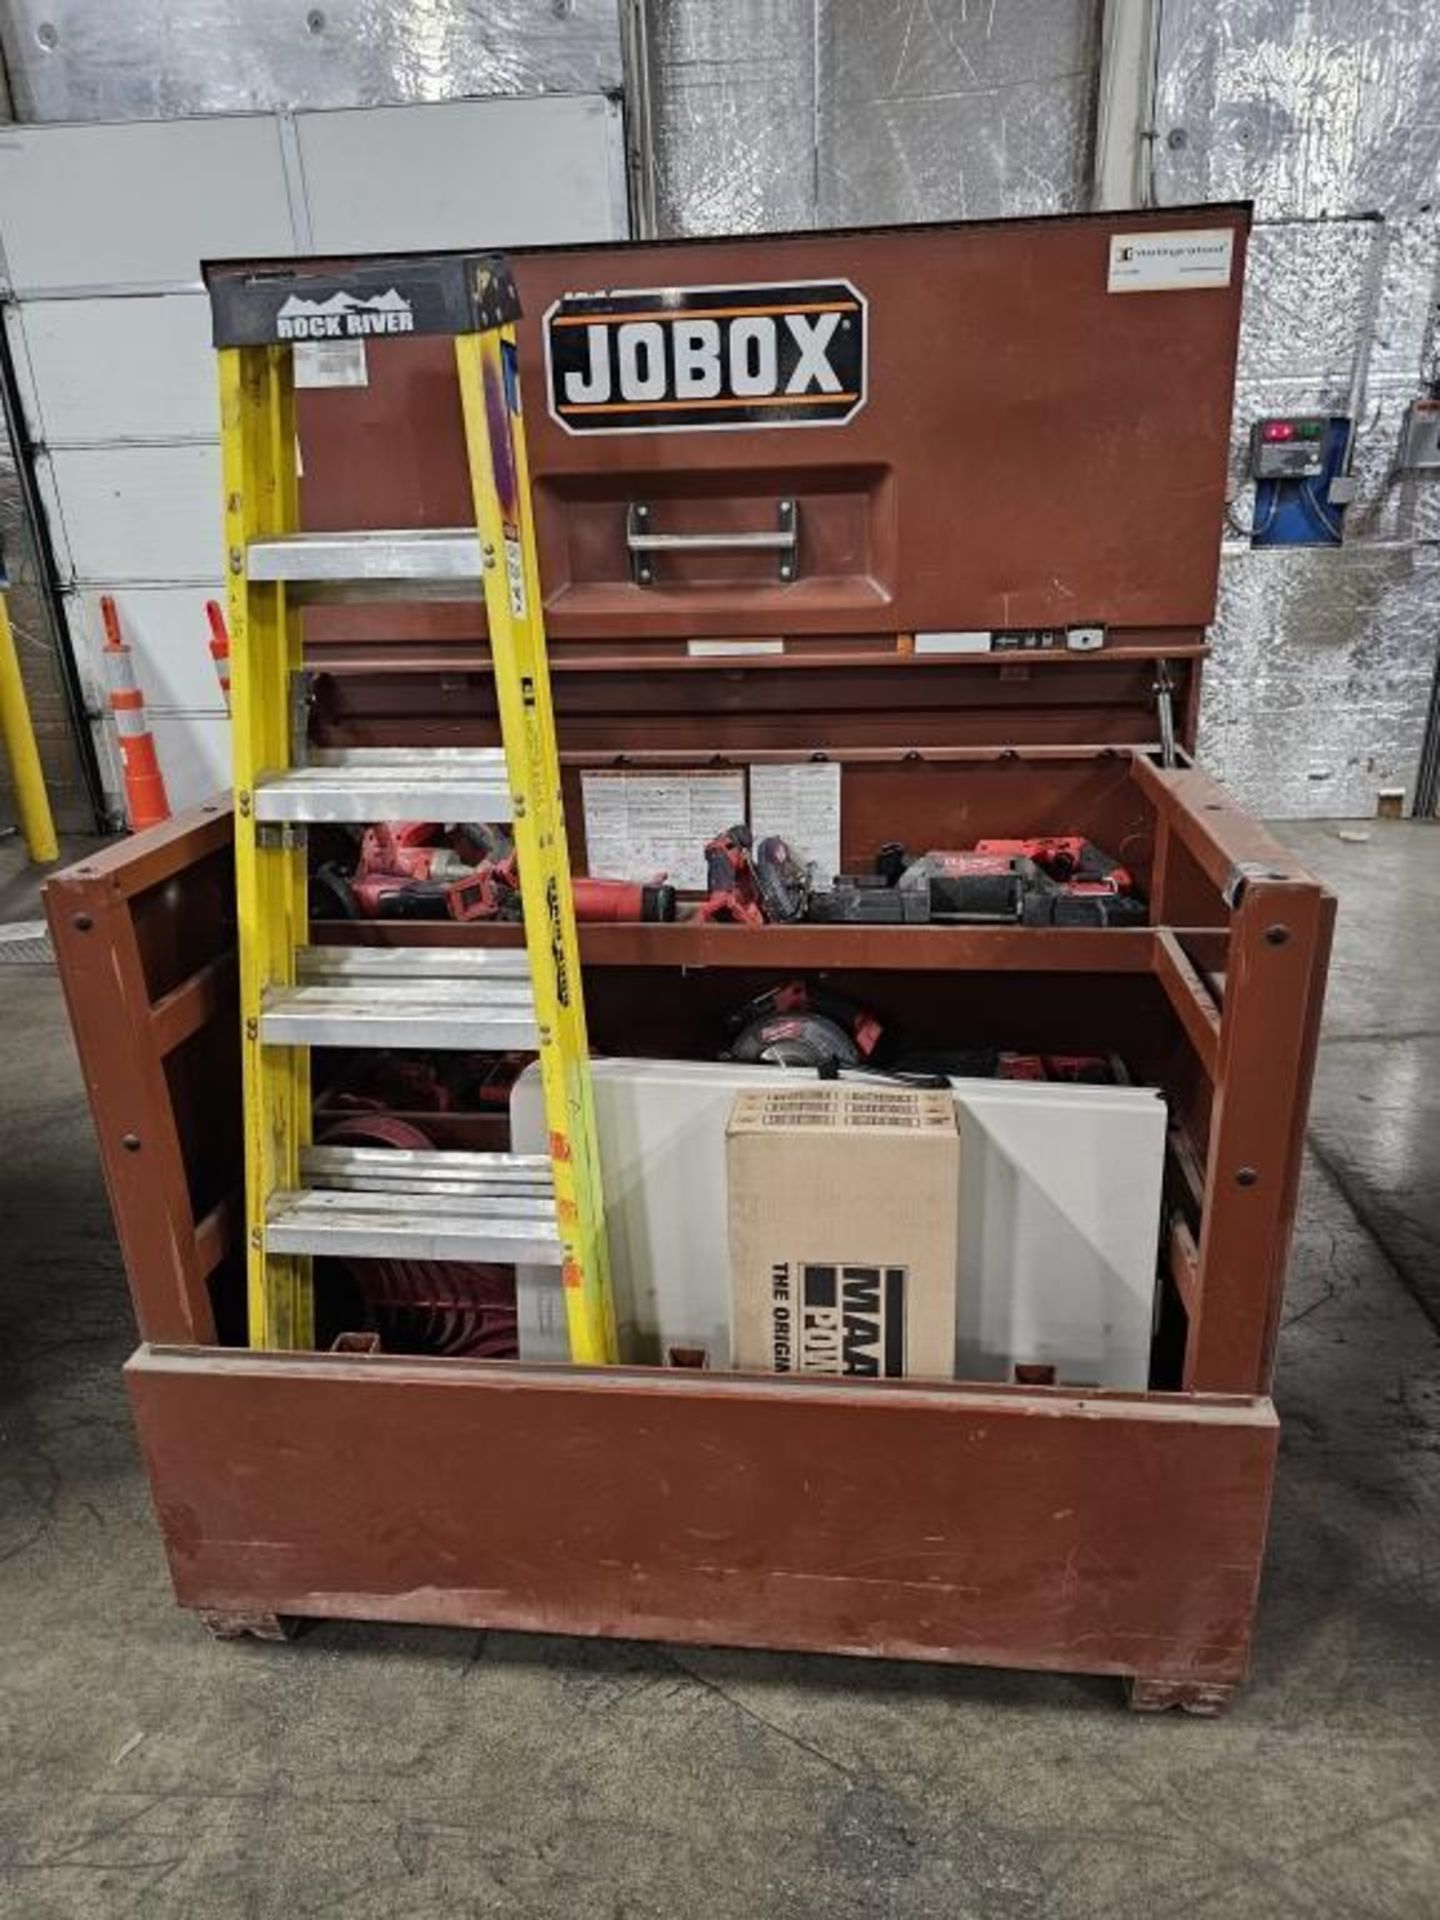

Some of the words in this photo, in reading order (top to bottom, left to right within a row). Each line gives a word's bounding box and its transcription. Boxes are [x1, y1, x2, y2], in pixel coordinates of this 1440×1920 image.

[277, 317, 342, 338] ROCK
[346, 312, 413, 334] RIVER
[564, 312, 843, 404] JOBOX
[772, 1262, 789, 1301] THE
